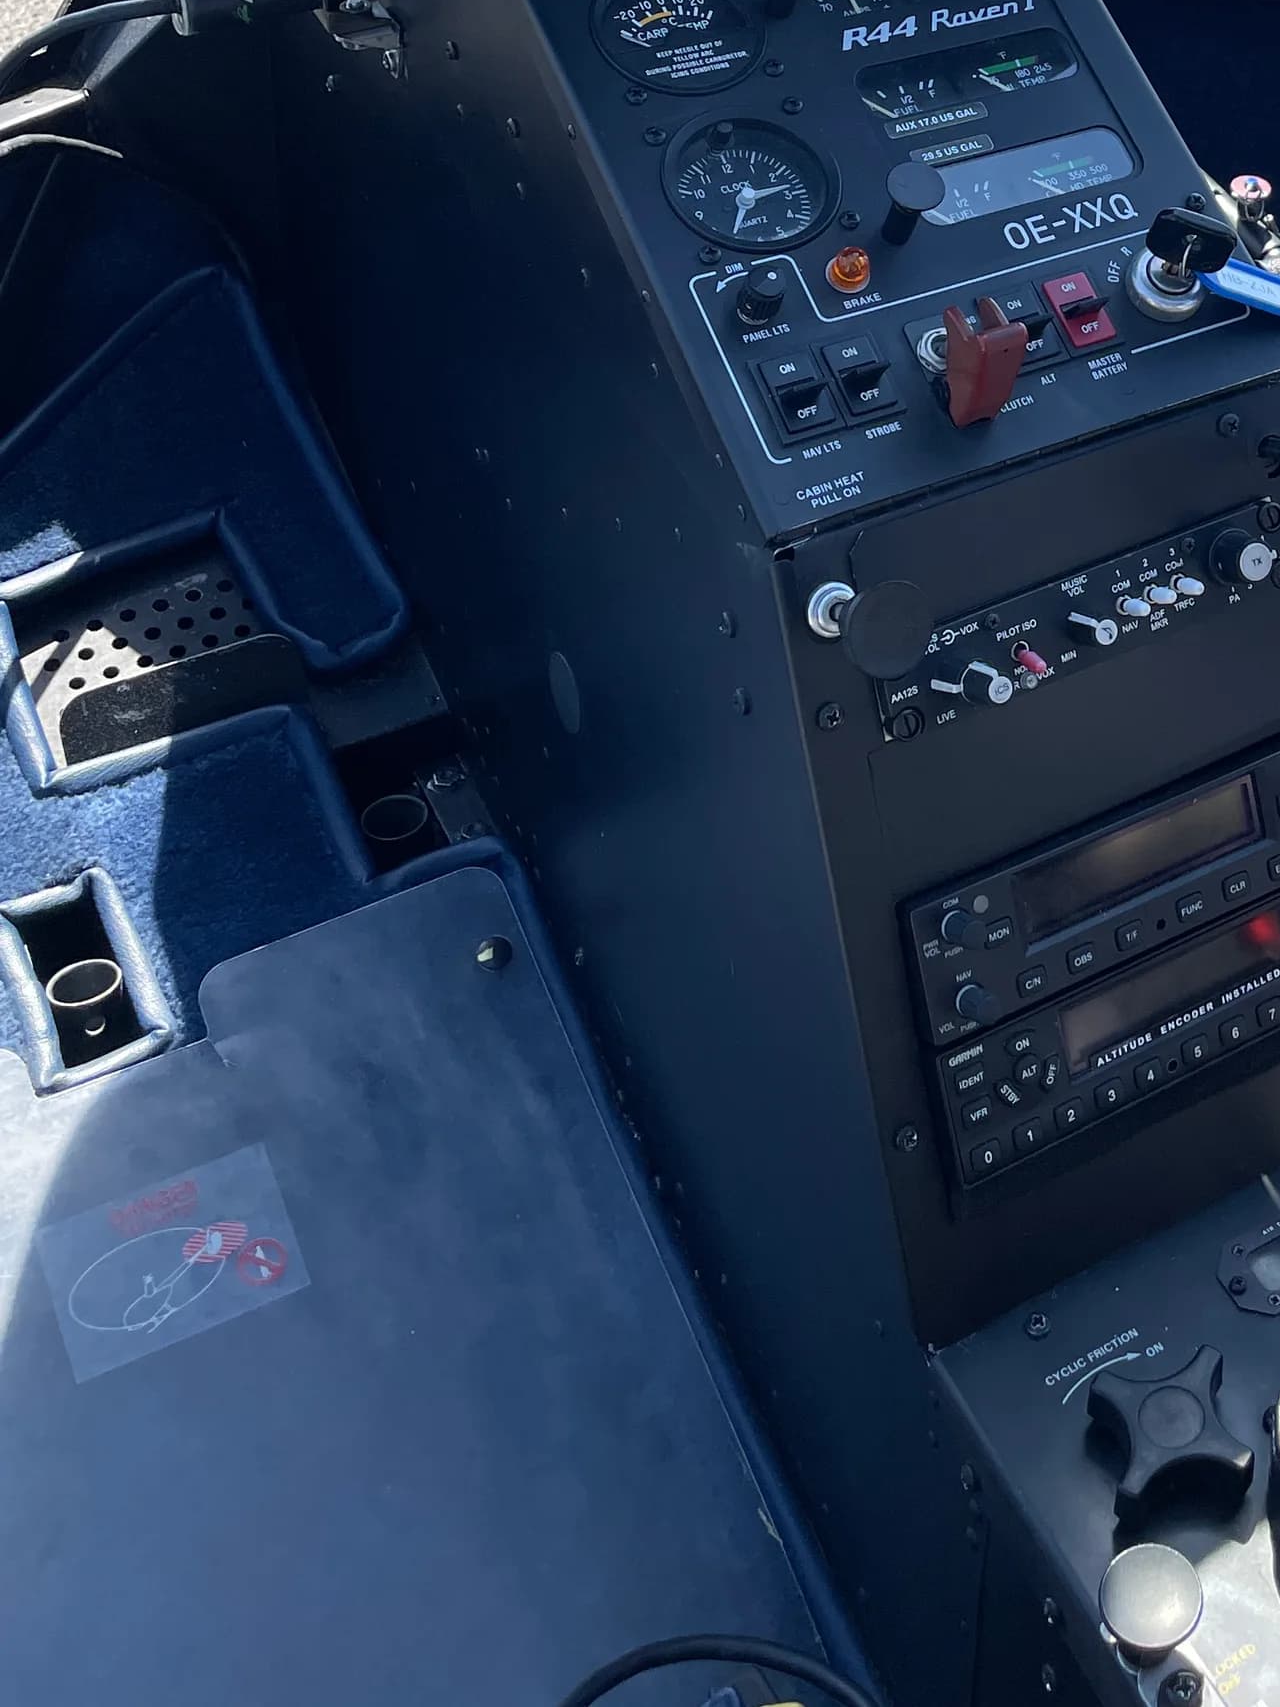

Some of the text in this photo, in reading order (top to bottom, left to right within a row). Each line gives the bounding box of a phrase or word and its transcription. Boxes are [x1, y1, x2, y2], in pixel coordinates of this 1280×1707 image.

[842, 16, 918, 52] R44
[931, 0, 1020, 32] Raven
[895, 107, 978, 133] AUX 17.0 US GAL
[921, 140, 983, 162] 29.5 US GAL
[1003, 193, 1139, 250] OE-XXQ
[724, 263, 744, 274] DIM
[1107, 261, 1121, 283] OFF
[1061, 283, 1076, 292] ON
[843, 293, 882, 310] BRAKE
[1007, 300, 1022, 310] ON
[742, 324, 790, 343] PANEL LTS
[1081, 321, 1099, 333] OFF
[1026, 339, 1044, 351] OFF
[842, 347, 857, 358] ON
[780, 363, 796, 373] ON
[1087, 353, 1122, 370] MASTER
[1092, 362, 1128, 380] BATTERY
[1040, 373, 1057, 385] ALT
[860, 389, 879, 401] OFF
[797, 405, 818, 418] OFF
[865, 422, 902, 439] STROBE
[802, 441, 841, 459] NAV LTS
[796, 471, 865, 500] CABIN HEAT
[811, 486, 861, 508] PULL ON
[1165, 558, 1184, 572] COM
[1061, 575, 1088, 591] MUSIC
[1139, 569, 1158, 583] COM
[1067, 586, 1085, 598] VOL
[1111, 580, 1131, 593] COM
[1174, 598, 1195, 612] TRFC
[1150, 610, 1165, 621] ADF
[959, 622, 979, 635] VOX
[996, 619, 1037, 641] PILOT ISO
[1122, 621, 1139, 634] NAV
[1151, 618, 1169, 631] MKR
[1061, 650, 1077, 662] MIN
[937, 709, 957, 724] LIVE
[1230, 880, 1246, 894] CLR
[1181, 900, 1203, 917] FUNC
[988, 926, 1010, 942] MON
[1074, 952, 1092, 966] OBS
[1025, 977, 1041, 991] C/N
[1097, 968, 1280, 1068] ALTITUDE ENCODER INSTALLED
[1015, 1038, 1030, 1052] ON
[949, 1044, 984, 1067] GARMIN
[1022, 1065, 1037, 1079] ALT
[1046, 1063, 1057, 1084] OFF
[959, 1072, 984, 1090] IDENT
[1001, 1084, 1020, 1104] STBY
[970, 1107, 988, 1121] VFR
[1145, 1341, 1165, 1357] ON
[1045, 1327, 1139, 1386] CYCLIC FRICTION
